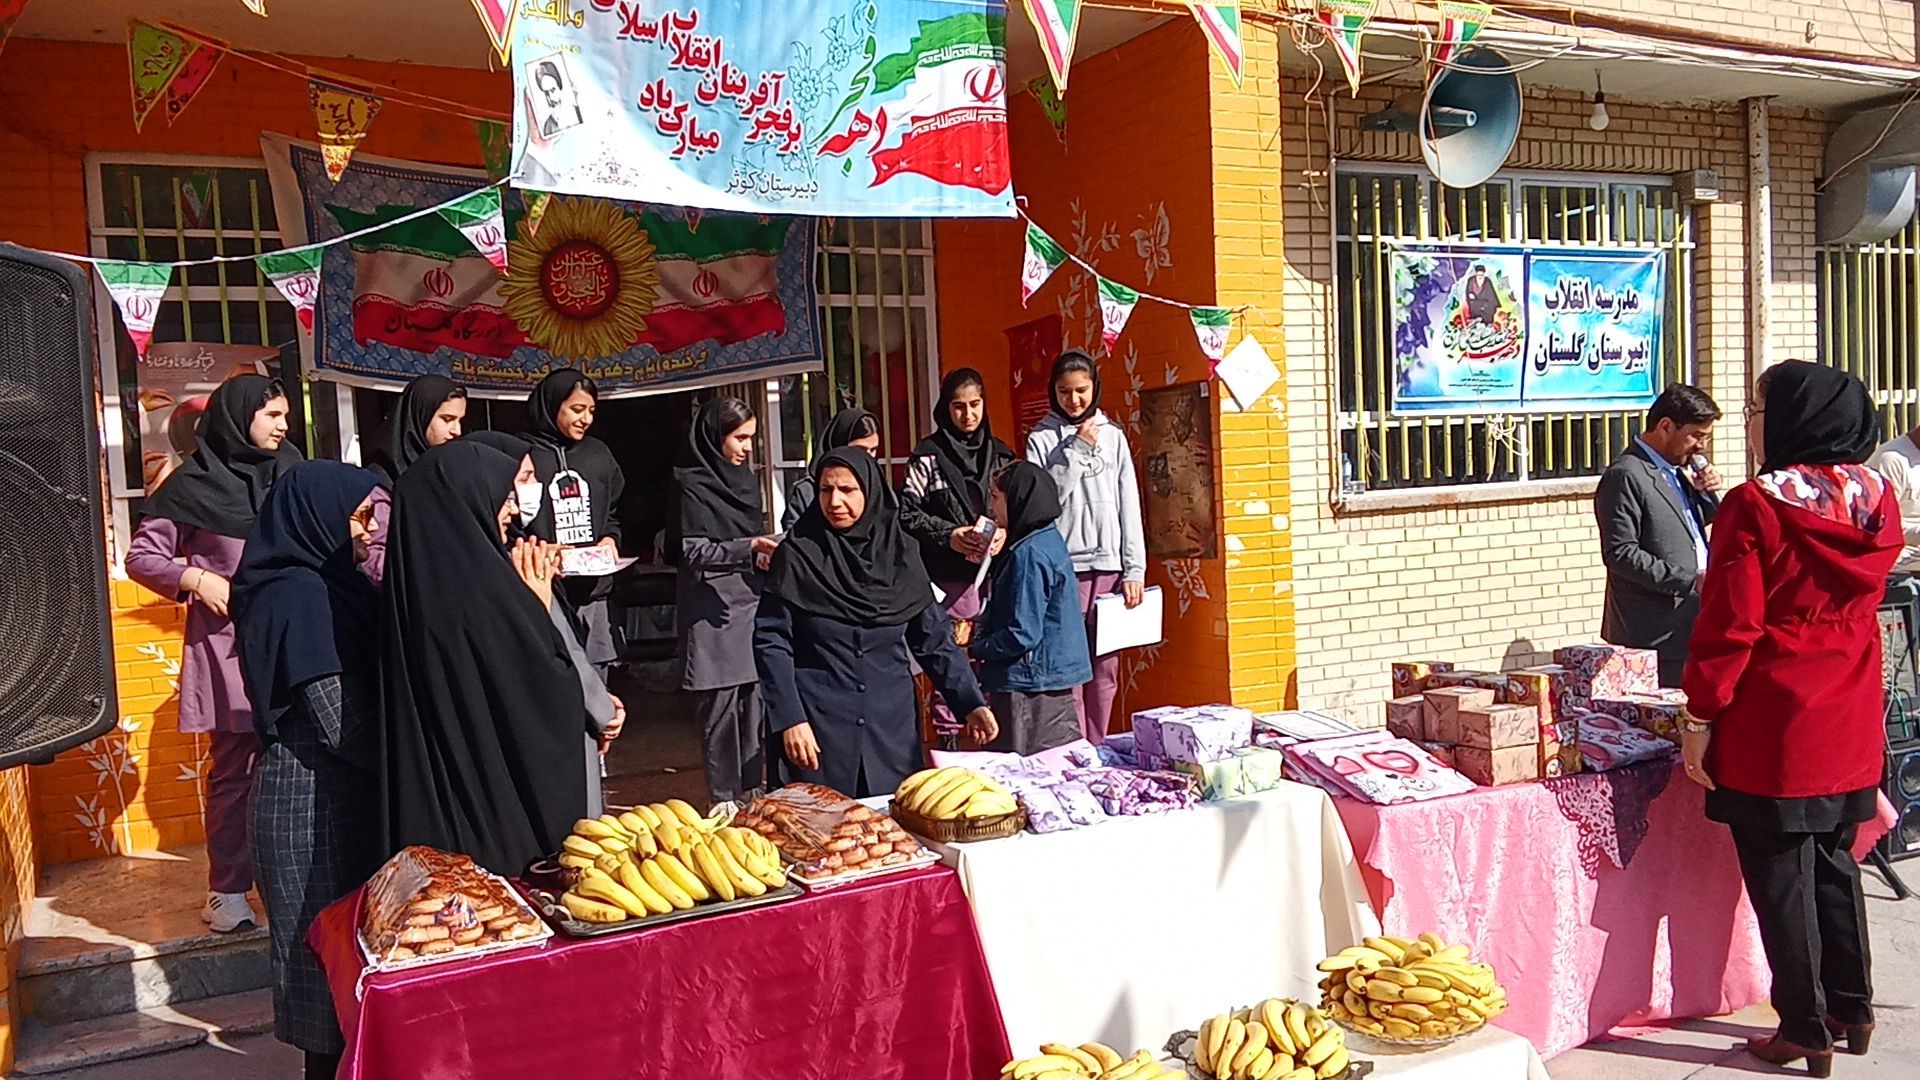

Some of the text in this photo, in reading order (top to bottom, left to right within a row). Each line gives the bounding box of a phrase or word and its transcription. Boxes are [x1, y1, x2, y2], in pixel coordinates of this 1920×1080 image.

[640, 78, 720, 155] مبارک باد
[746, 100, 793, 140] فجر
[779, 121, 802, 152] بر
[725, 169, 819, 199] دبیرستان کوثر
[1544, 279, 1639, 320] مدرسه انقلاب
[453, 357, 477, 382] باد
[1534, 331, 1586, 372] گلستان
